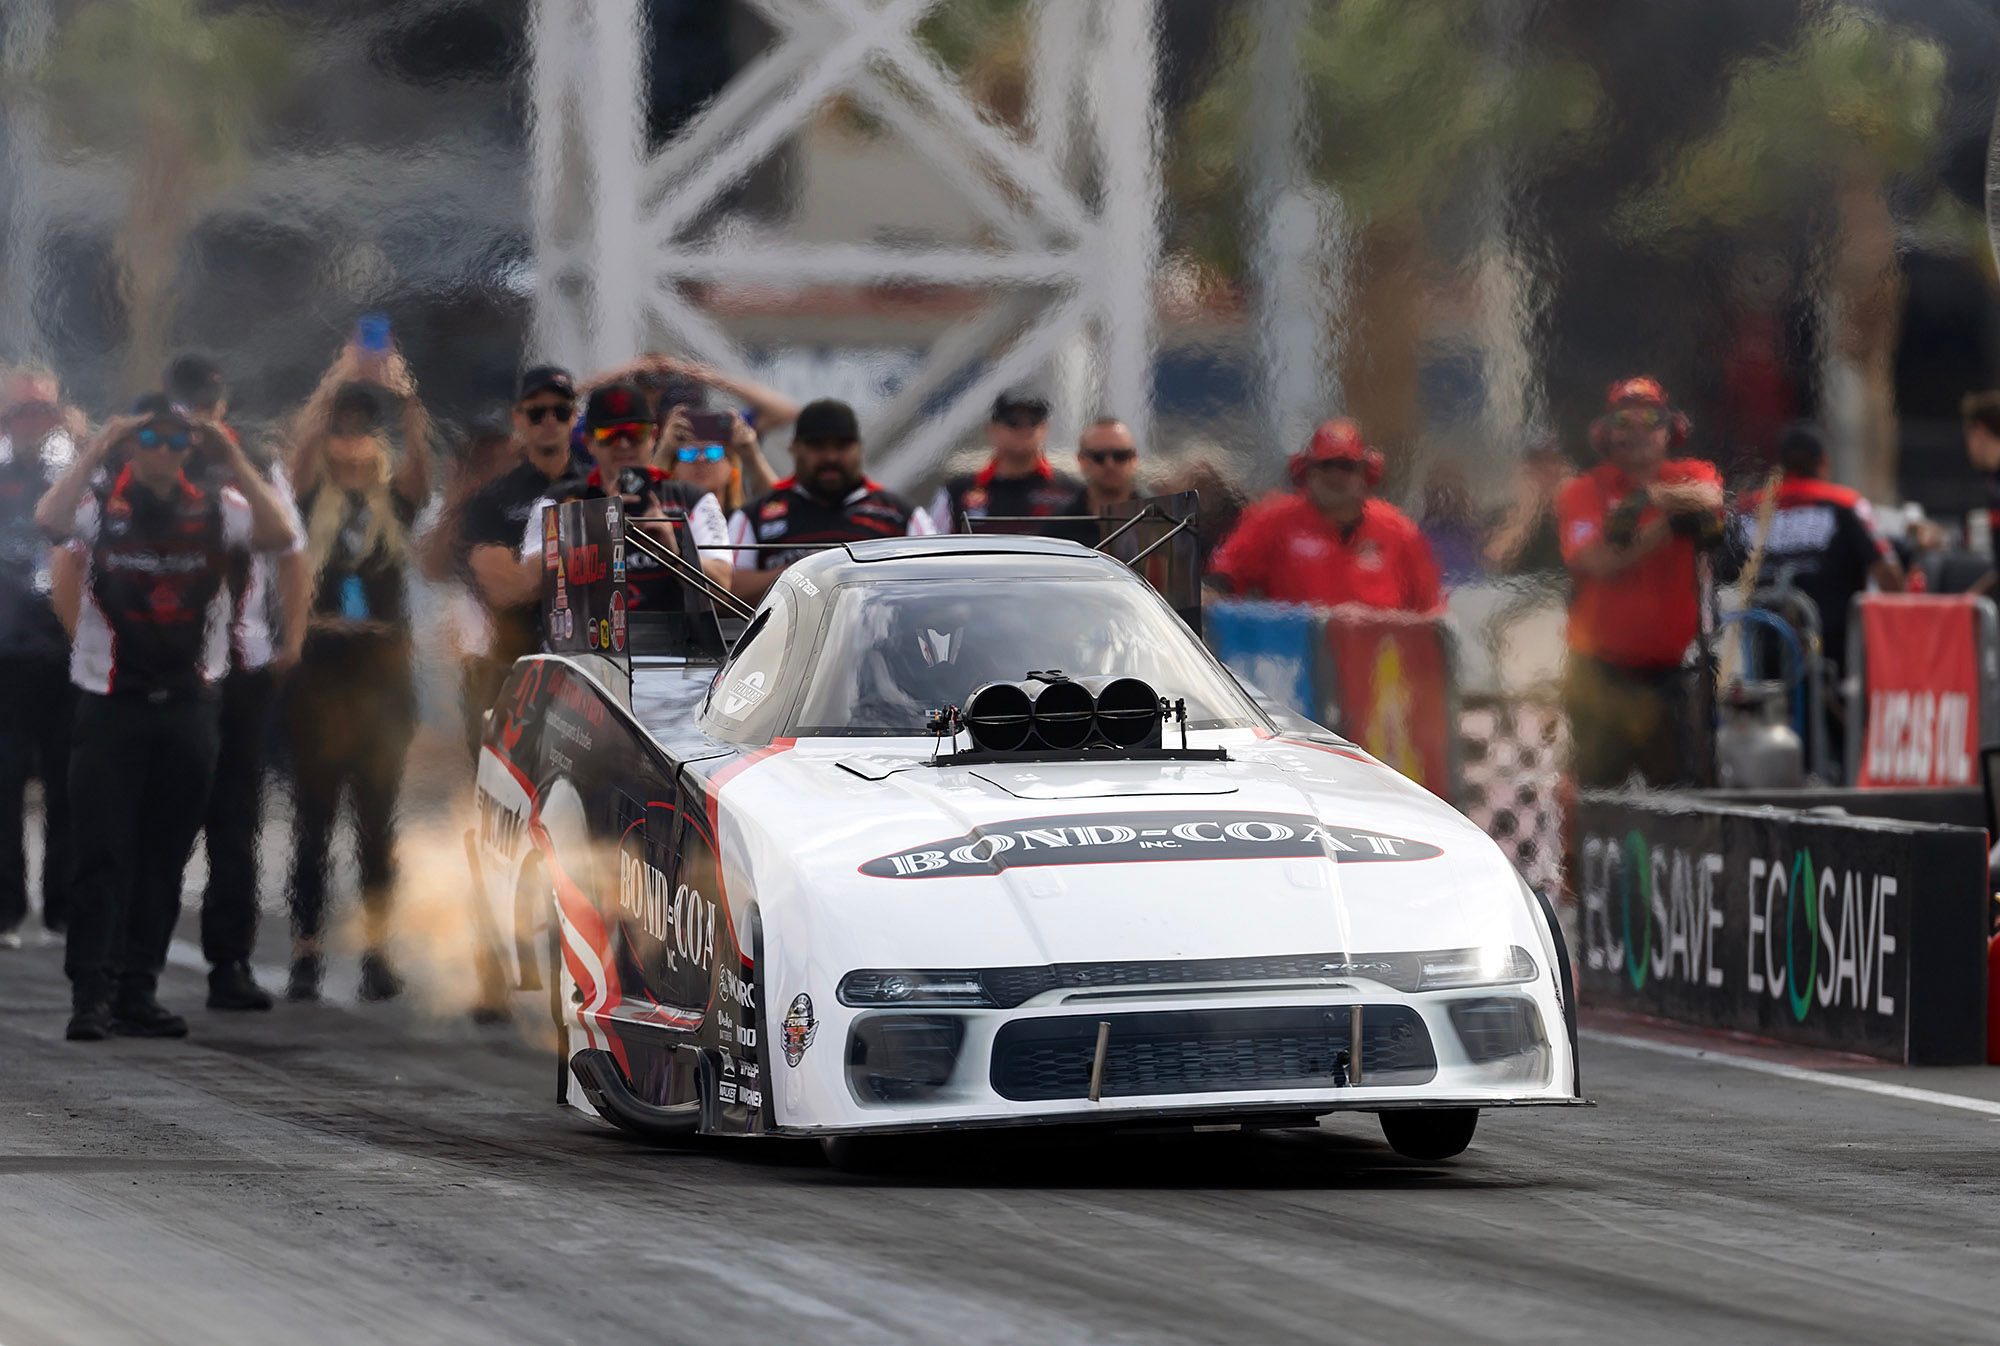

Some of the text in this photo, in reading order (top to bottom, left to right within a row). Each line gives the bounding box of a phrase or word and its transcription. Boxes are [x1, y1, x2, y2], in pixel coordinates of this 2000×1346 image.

[1868, 690, 1970, 782] LUCAS OIL
[888, 821, 1406, 876] BOND-COAT
[1139, 840, 1183, 849] INC.
[620, 848, 716, 971] BOND-COA
[1582, 829, 1898, 1022] ECOSAVE ECOSAVE
